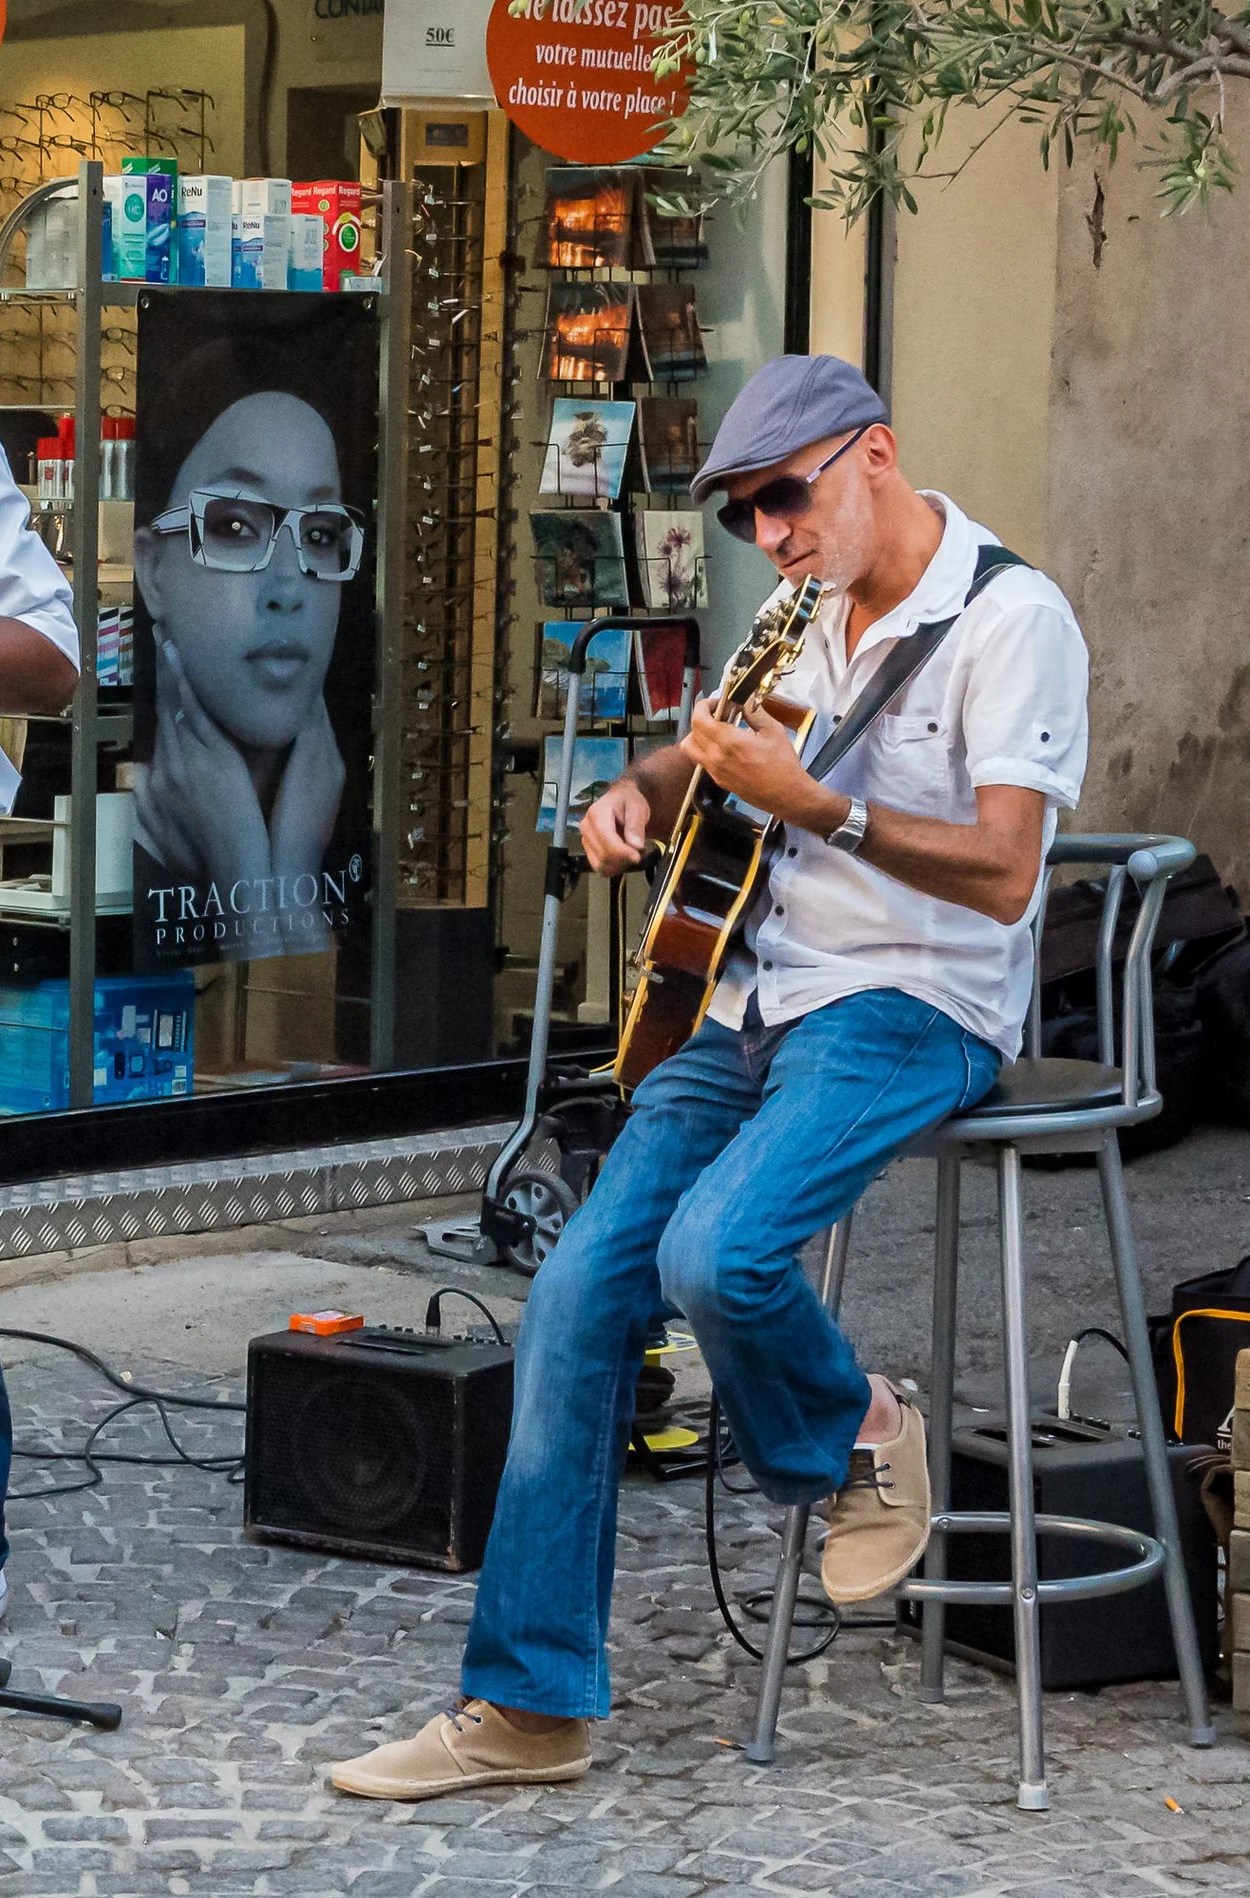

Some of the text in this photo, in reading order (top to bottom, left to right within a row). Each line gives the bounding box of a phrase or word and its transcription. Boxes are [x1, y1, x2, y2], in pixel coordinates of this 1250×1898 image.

[426, 27, 455, 43] 50€
[536, 43, 652, 72] votre mutuelle
[508, 77, 564, 107] choisir
[566, 81, 577, 108] à
[581, 88, 621, 112] votre
[624, 86, 666, 119] place
[152, 188, 168, 203] AO
[181, 186, 203, 198] ReNu
[313, 186, 336, 197] Regard
[338, 185, 361, 197] Regard
[242, 221, 261, 230] ReNu
[147, 869, 347, 923] TRACTION
[155, 907, 350, 945] PRODUCTIONS
